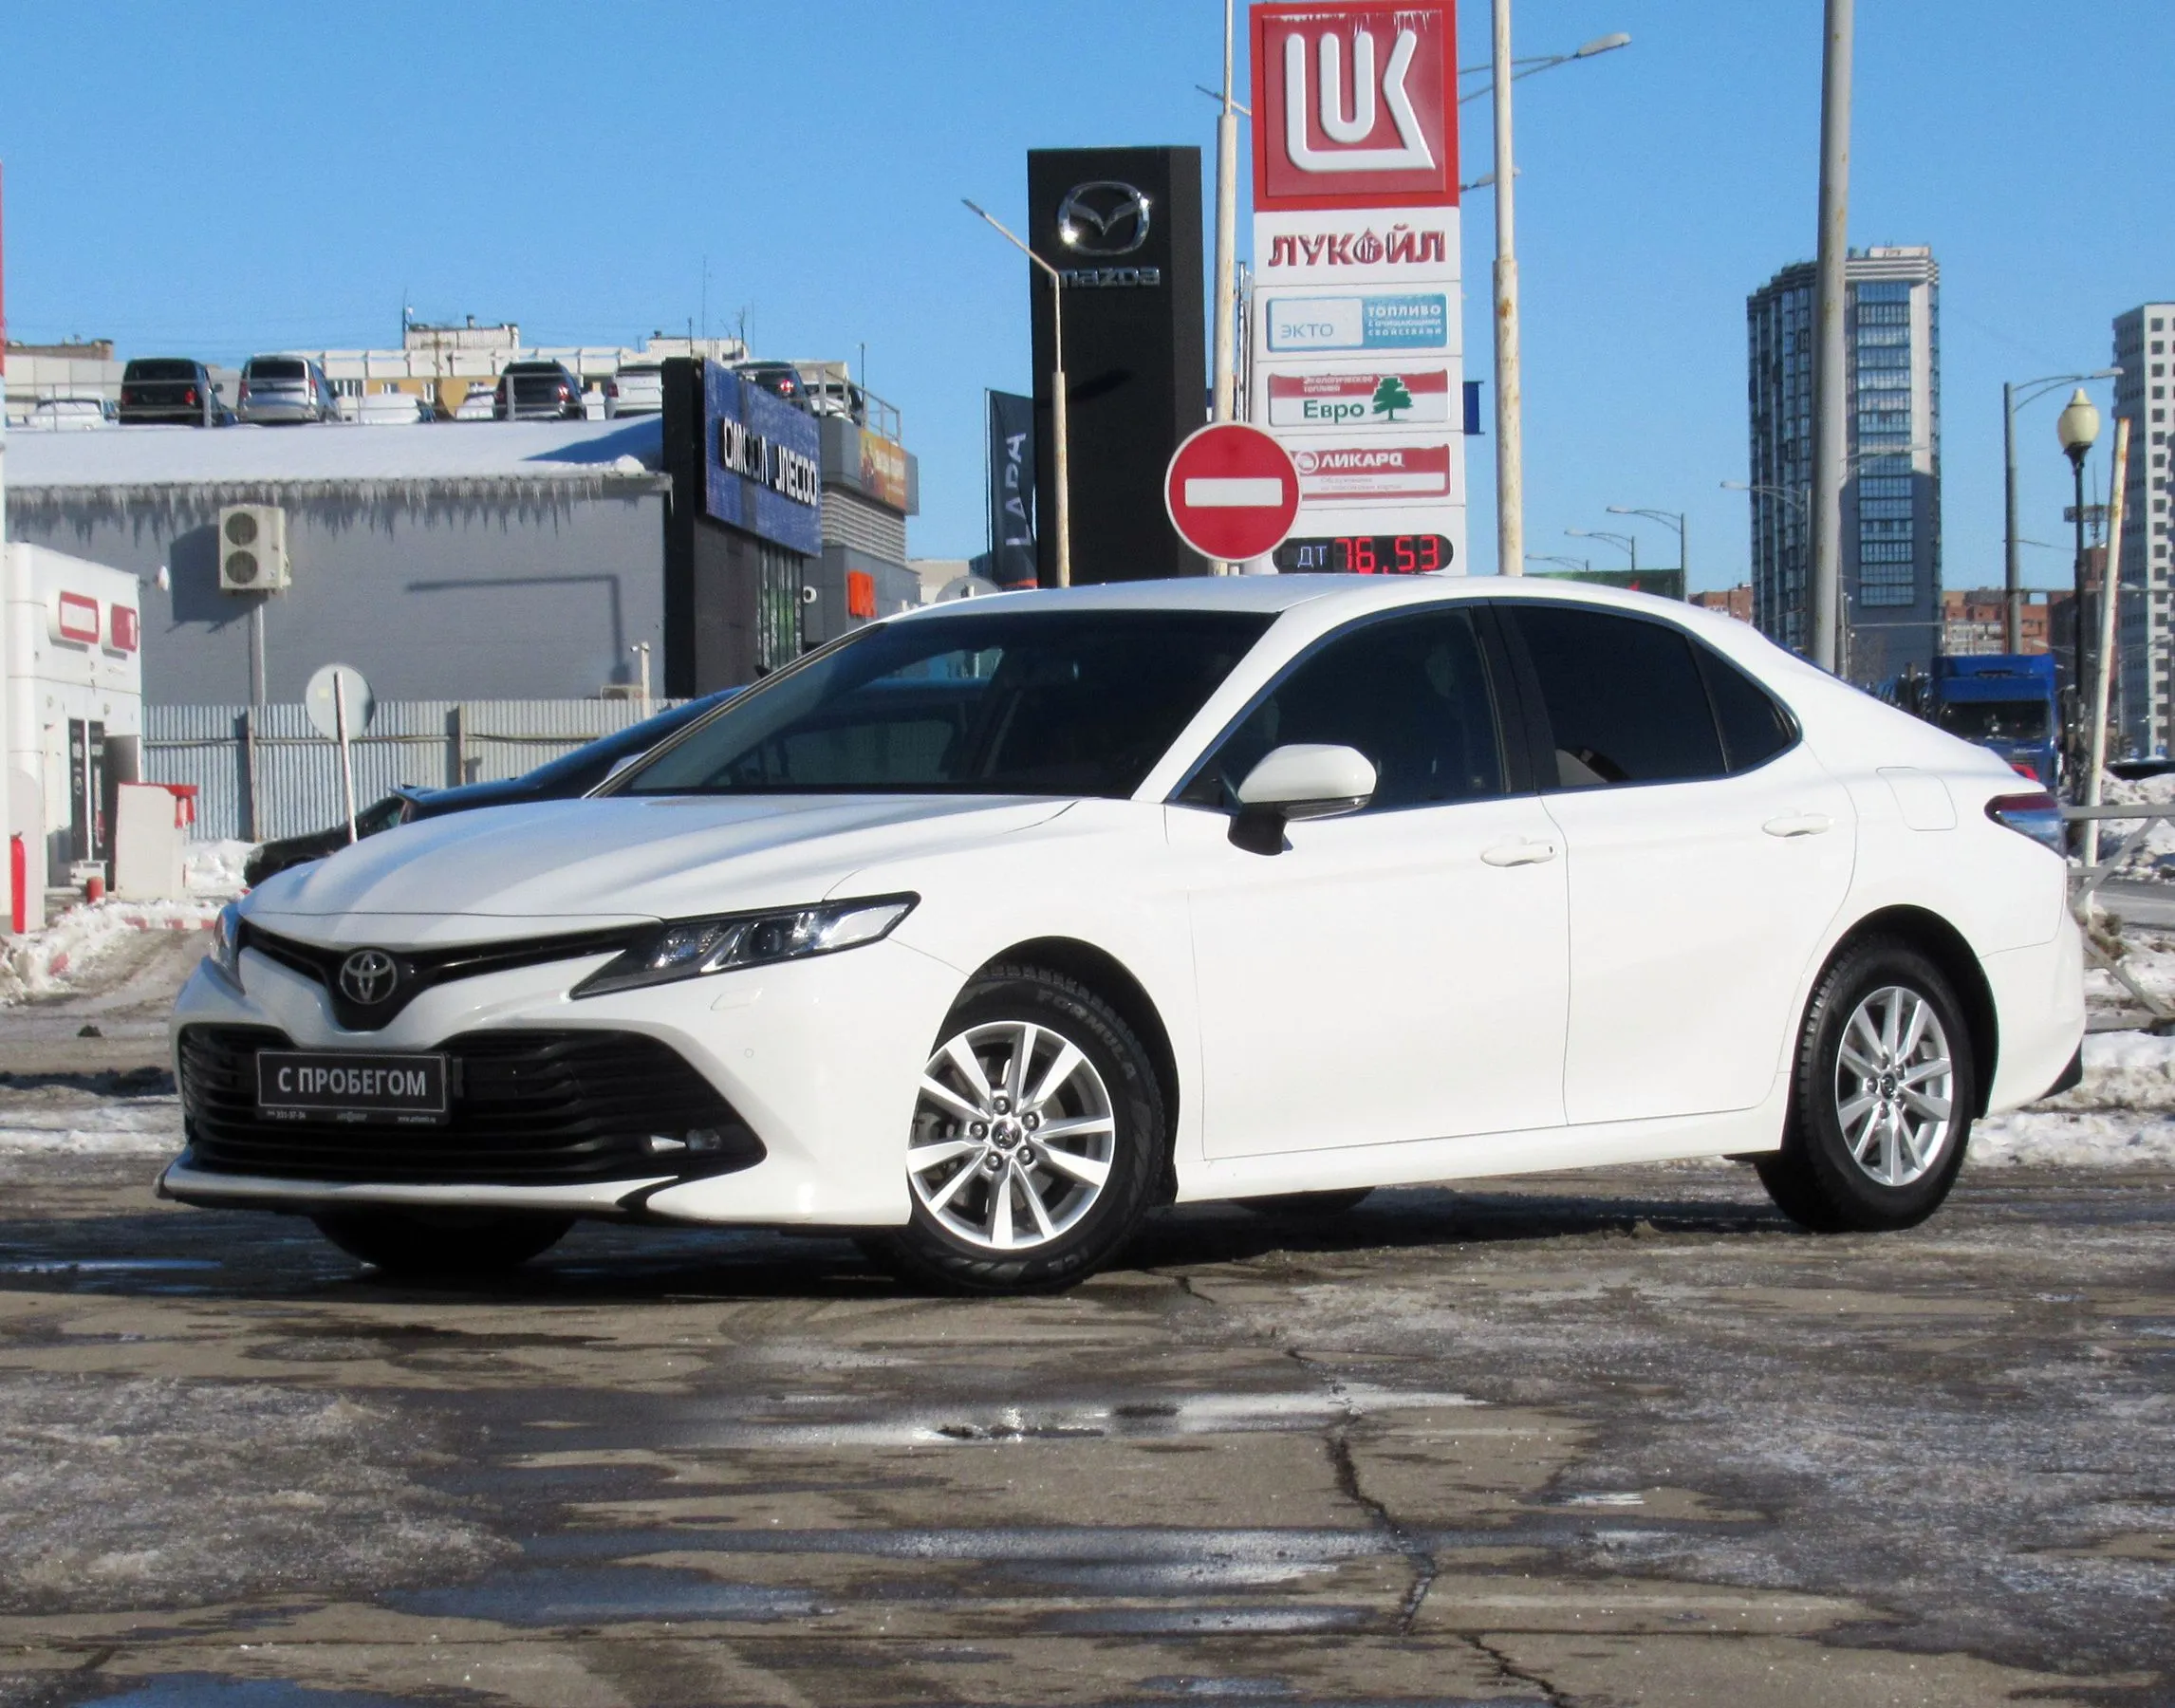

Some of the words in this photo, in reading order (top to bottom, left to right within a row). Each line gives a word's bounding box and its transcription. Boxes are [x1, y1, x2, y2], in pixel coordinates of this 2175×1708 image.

[1268, 223, 1446, 267] ЛУКОЙЛ
[1281, 324, 1333, 339] ЭКТО
[1304, 399, 1366, 424] Евро
[1006, 433, 1032, 546] LADA
[1297, 547, 1328, 567] ДТ
[1335, 535, 1439, 574] 76.53
[278, 1068, 291, 1092] С
[298, 1068, 426, 1096] ПРОБЕГОМ
